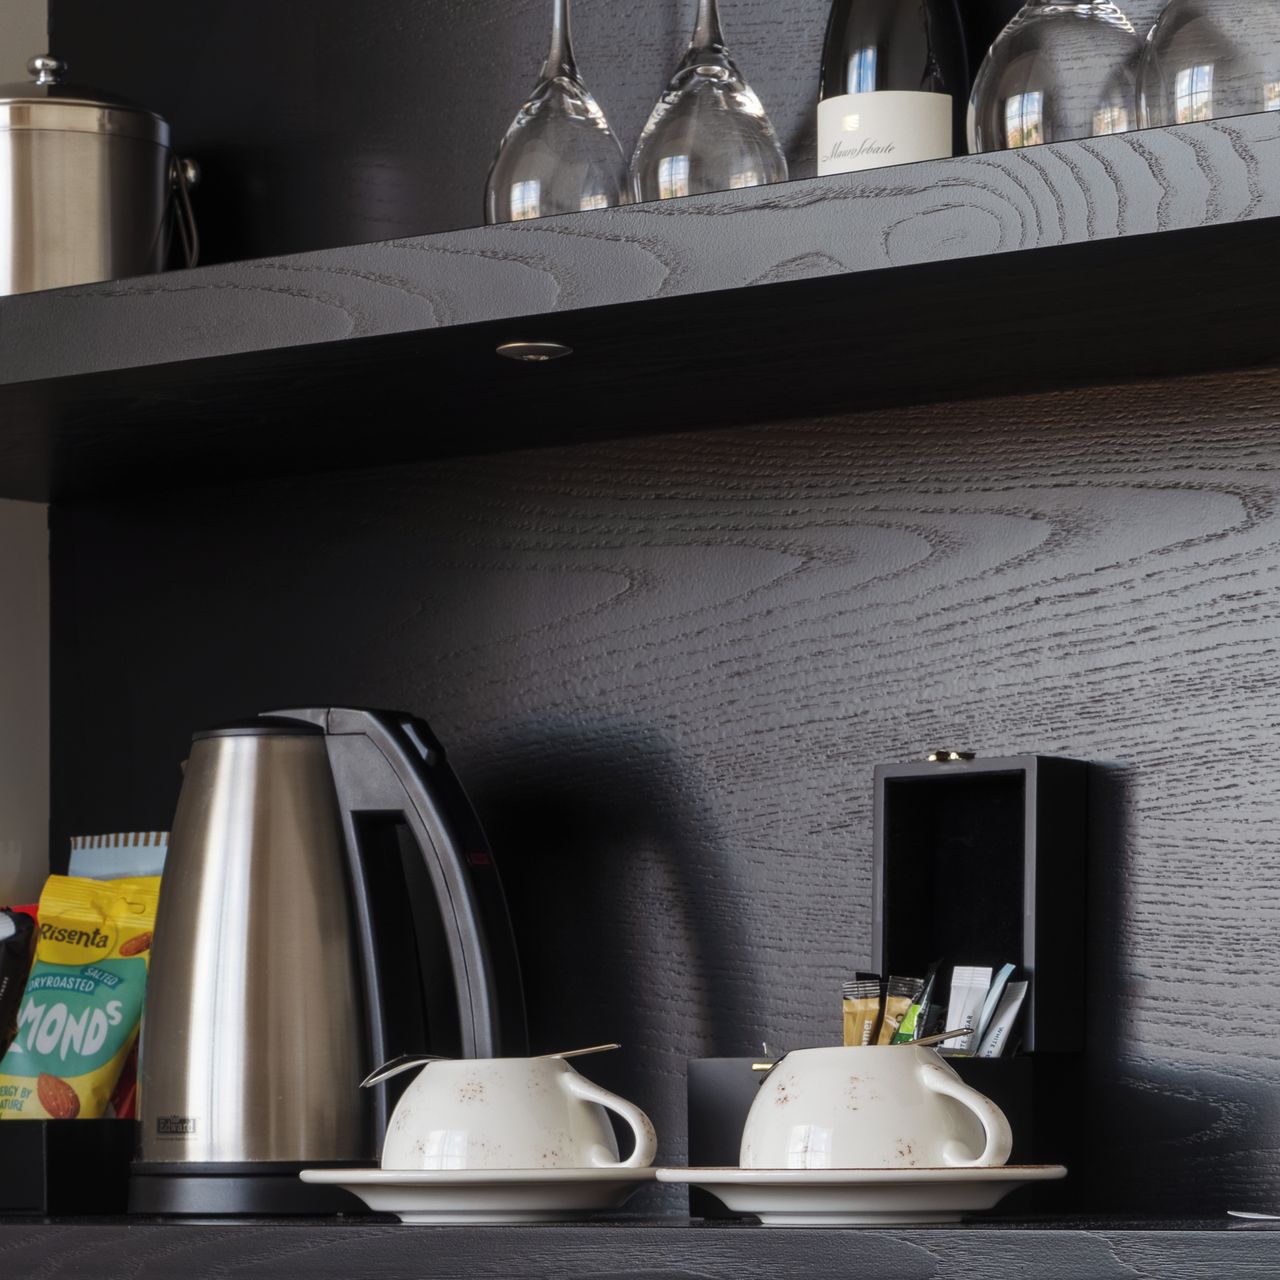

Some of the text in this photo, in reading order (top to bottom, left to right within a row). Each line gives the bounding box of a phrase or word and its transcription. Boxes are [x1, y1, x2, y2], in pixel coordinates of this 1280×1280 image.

[40, 923, 110, 949] Risenta
[84, 967, 118, 987] SALTED
[990, 1026, 1004, 1048] WHITE
[21, 1086, 33, 1098] BY
